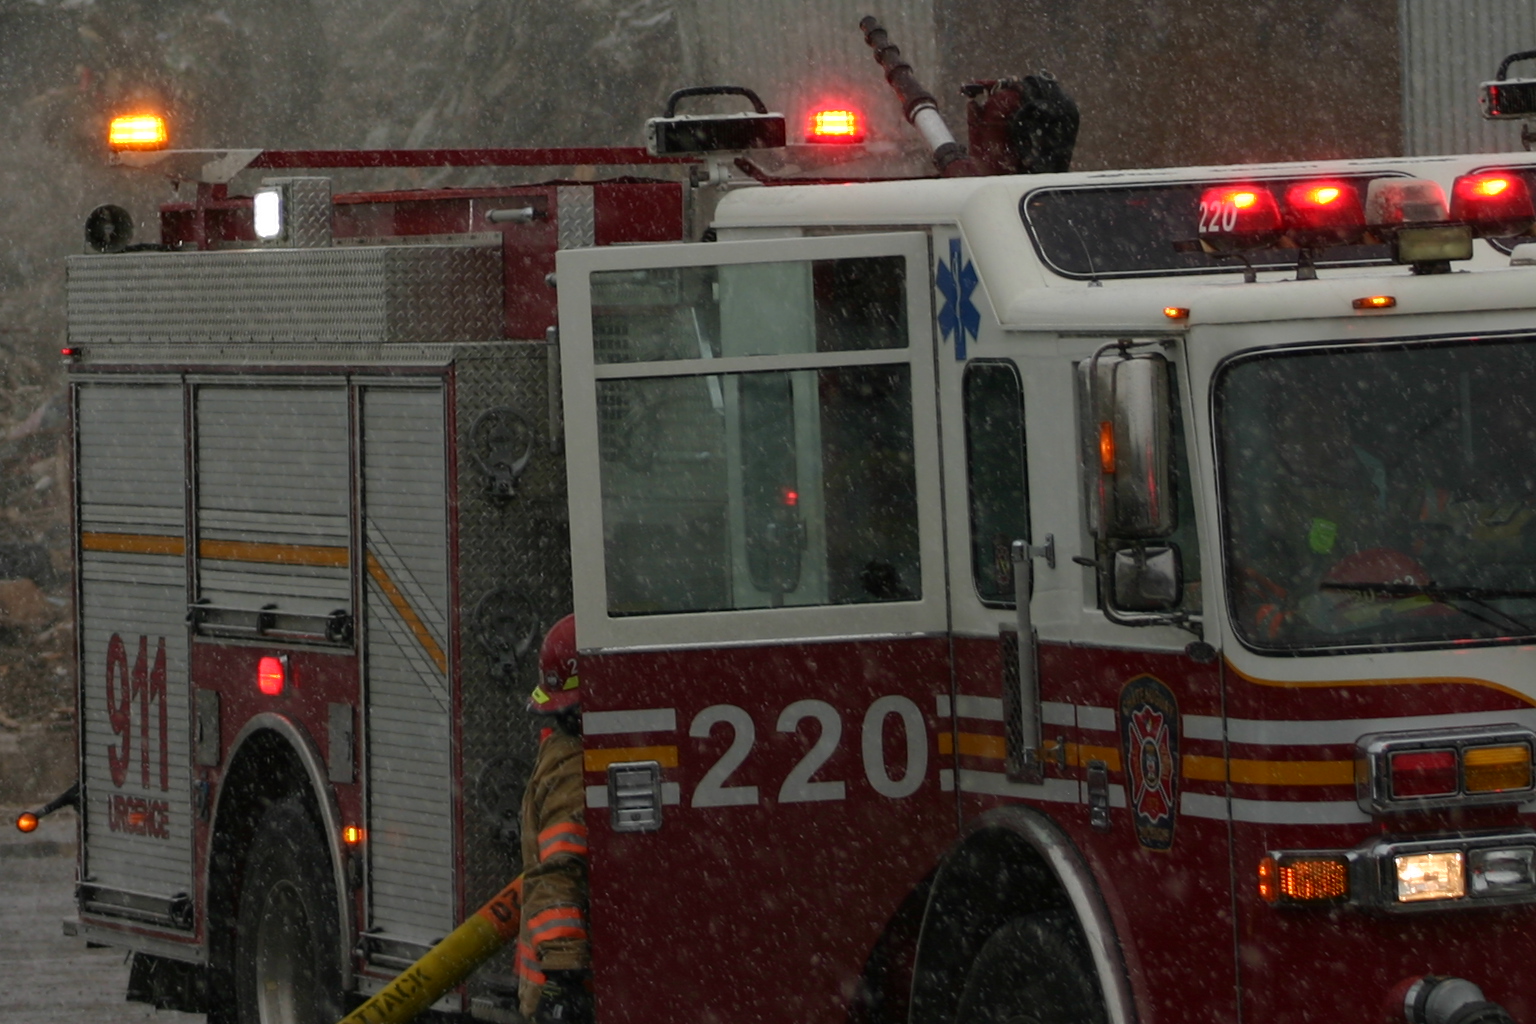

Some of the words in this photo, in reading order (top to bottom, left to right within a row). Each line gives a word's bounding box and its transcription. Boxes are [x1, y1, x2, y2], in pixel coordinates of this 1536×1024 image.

[1199, 200, 1239, 233] 220
[106, 632, 169, 792] 911
[688, 694, 928, 808] 220
[342, 967, 432, 1024] TTACK
